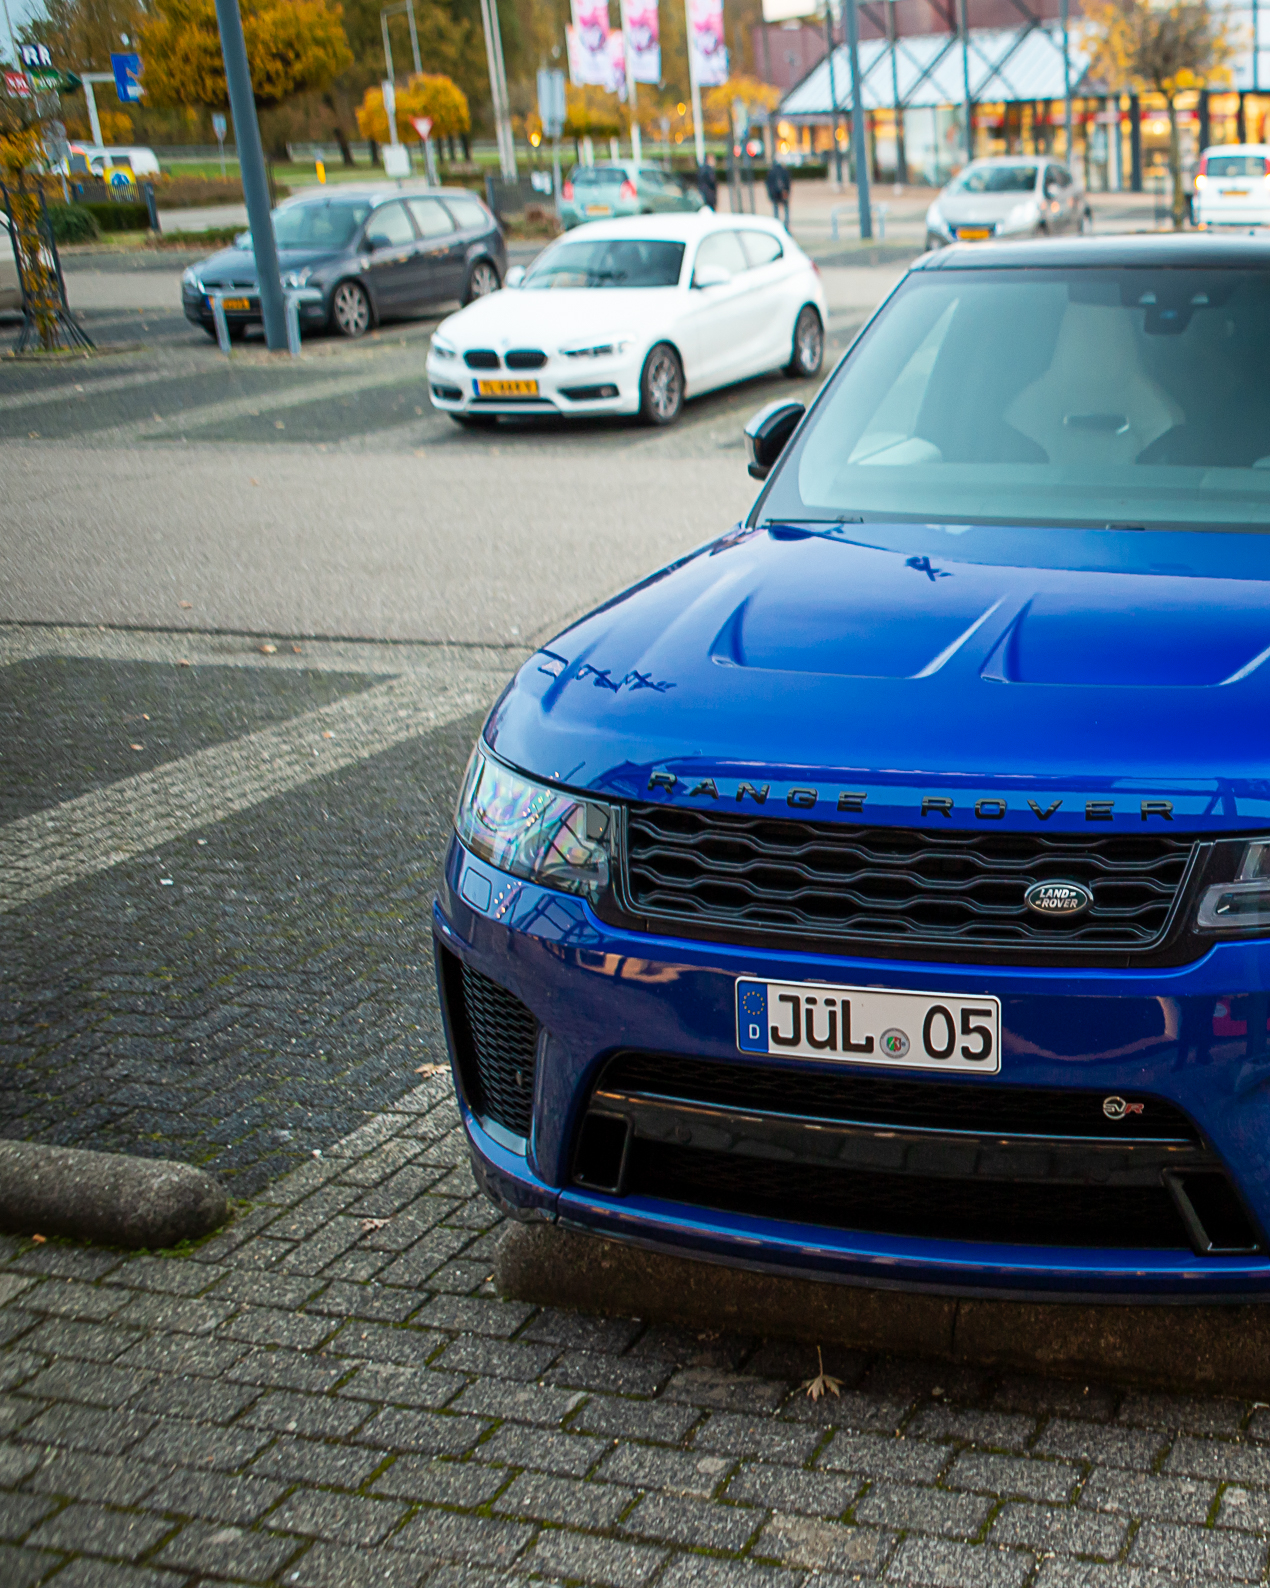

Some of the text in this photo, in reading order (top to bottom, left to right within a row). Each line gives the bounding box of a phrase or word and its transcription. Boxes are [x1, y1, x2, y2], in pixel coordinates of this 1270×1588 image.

[647, 770, 1176, 823] RANGE ROVER
[1039, 888, 1070, 899] LAND
[1041, 898, 1079, 909] ROVER
[747, 1023, 761, 1039] D
[921, 1004, 993, 1061] 05
